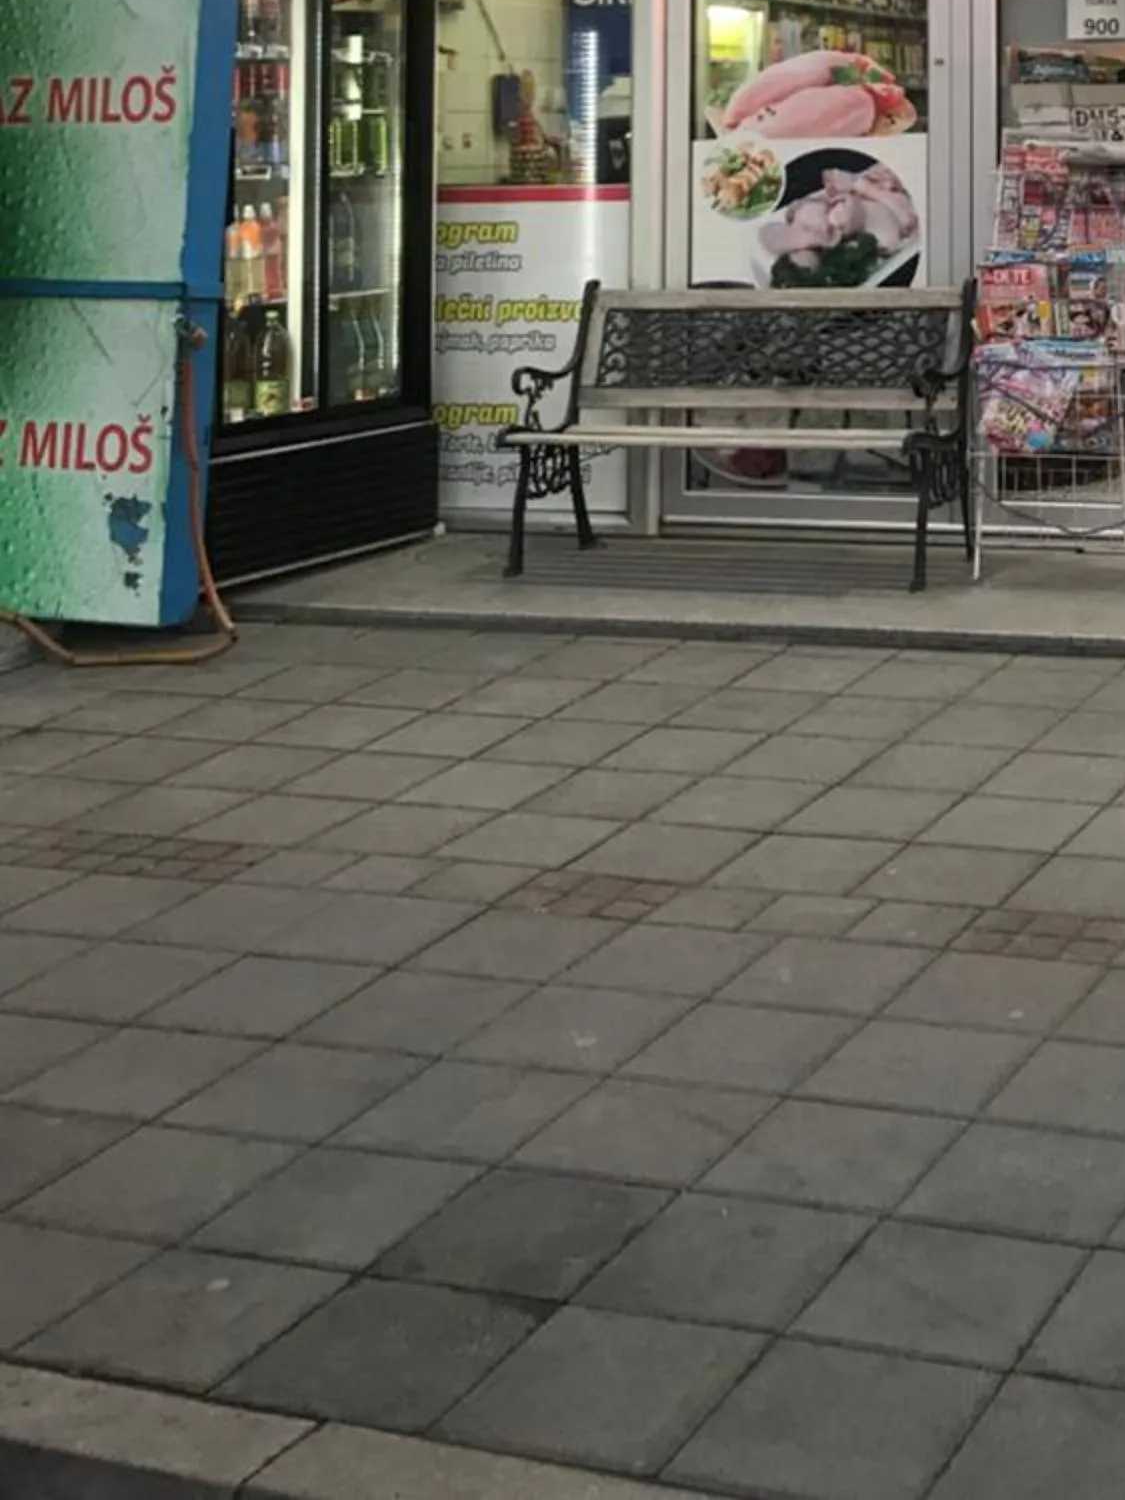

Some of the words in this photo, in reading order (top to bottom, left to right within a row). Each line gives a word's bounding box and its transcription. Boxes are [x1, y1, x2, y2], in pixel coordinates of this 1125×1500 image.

[1083, 18, 1120, 36] 900
[0, 77, 34, 124] Z
[47, 64, 177, 123] MILOŠ
[436, 221, 519, 249] ogram
[437, 293, 494, 323] lečni
[495, 294, 584, 327] proizv
[432, 403, 519, 430] ogram
[18, 413, 154, 475] MILOŠ
